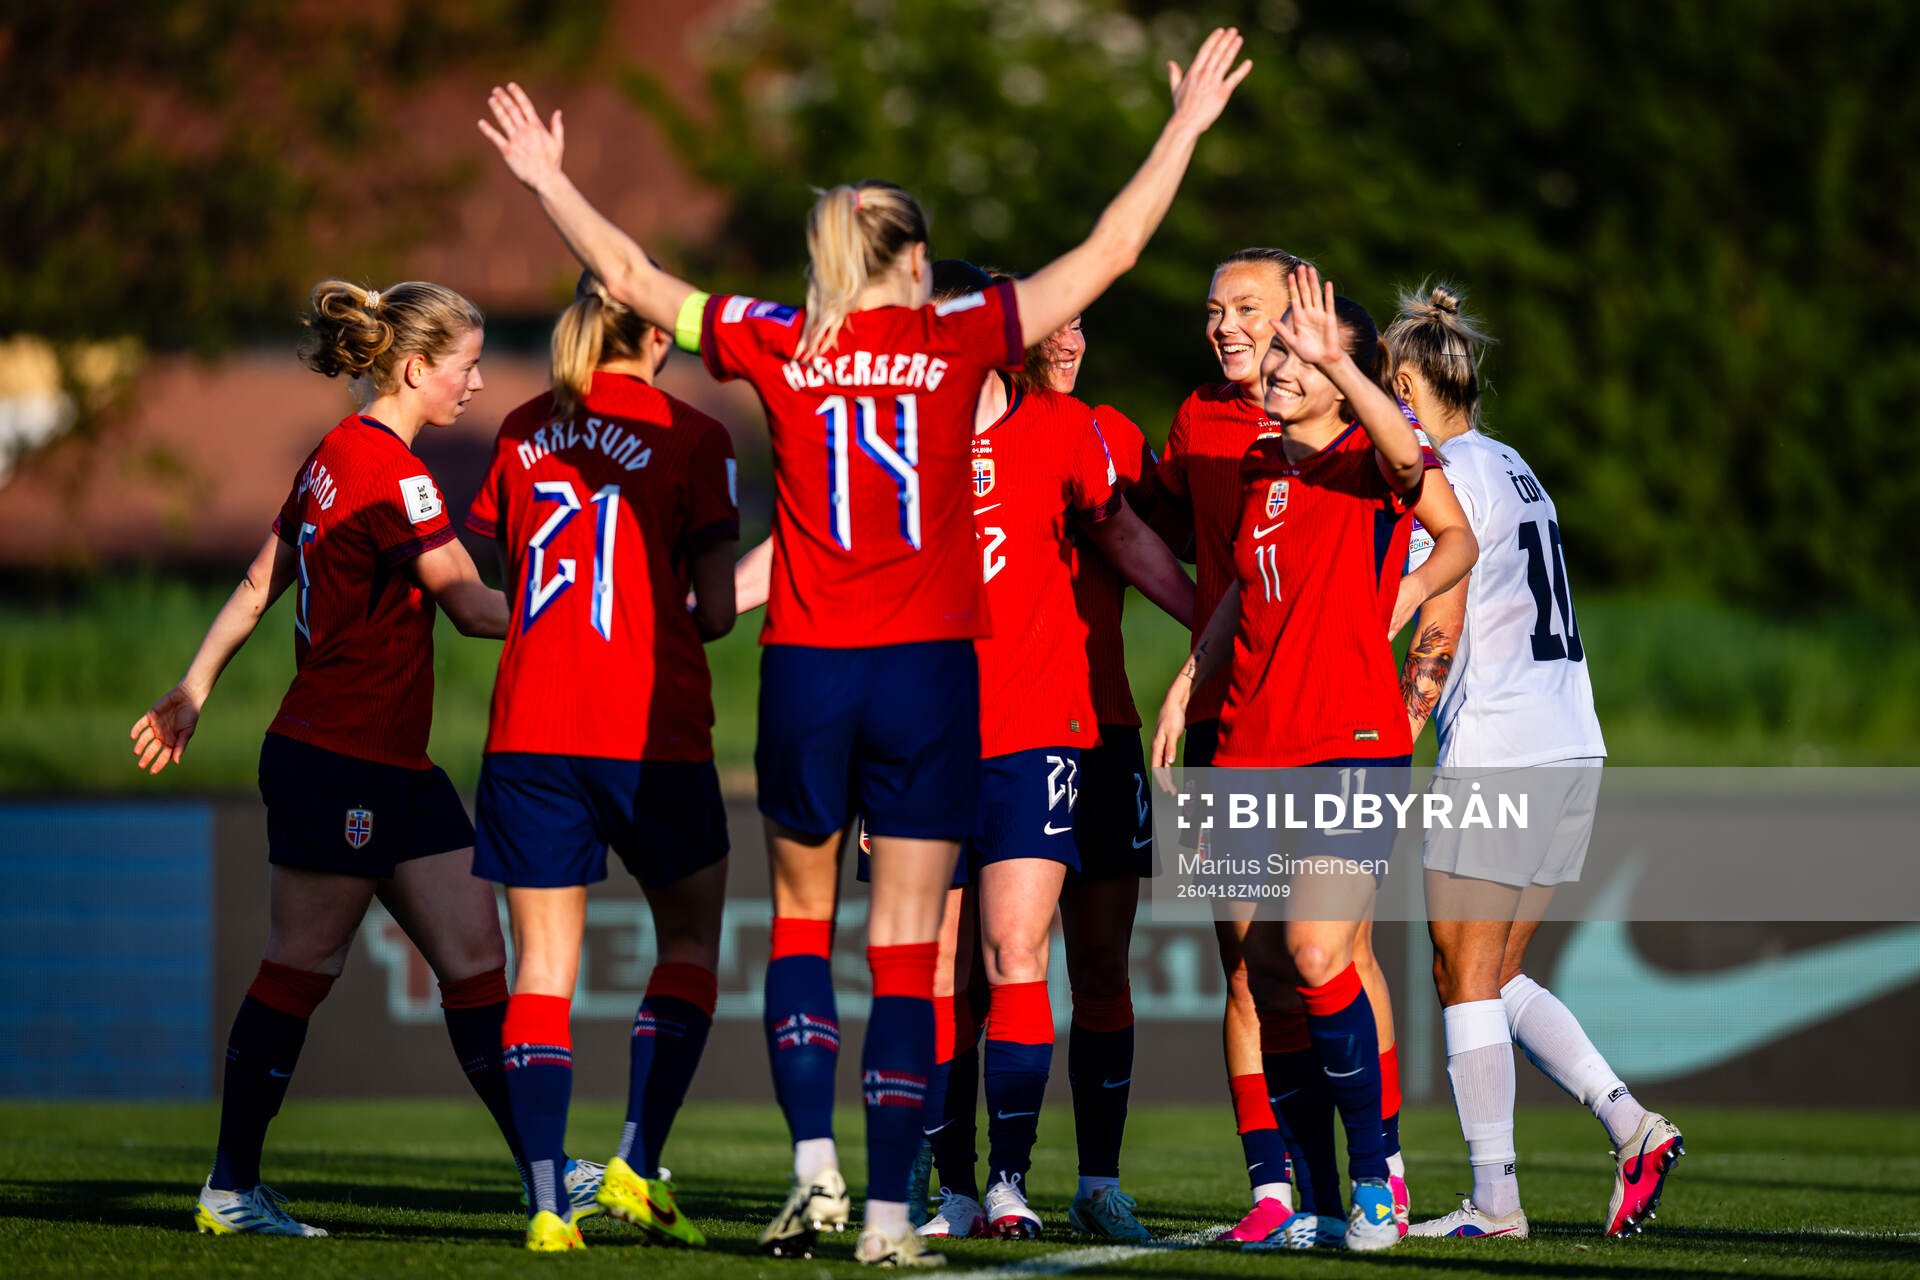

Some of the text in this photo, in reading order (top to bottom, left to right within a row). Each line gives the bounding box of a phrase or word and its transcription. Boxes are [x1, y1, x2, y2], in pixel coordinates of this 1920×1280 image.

[782, 351, 948, 391] HEGERBERG
[517, 418, 652, 470] NAALSUND
[816, 394, 921, 551] 14
[522, 481, 621, 643] 21
[976, 527, 1007, 584] 2
[1254, 544, 1282, 602] 11
[1518, 520, 1583, 662] 10
[1046, 755, 1078, 814] 22
